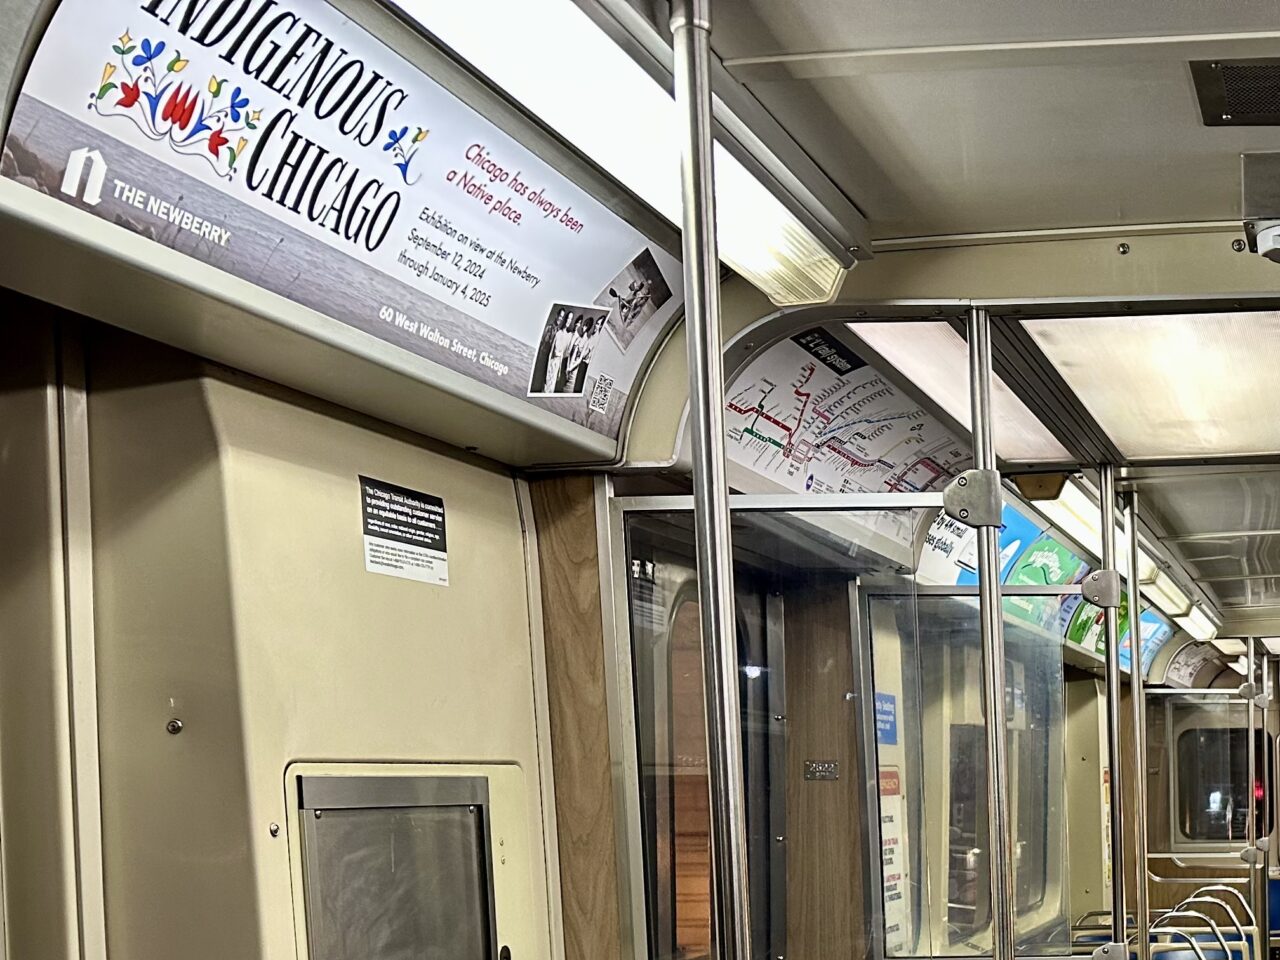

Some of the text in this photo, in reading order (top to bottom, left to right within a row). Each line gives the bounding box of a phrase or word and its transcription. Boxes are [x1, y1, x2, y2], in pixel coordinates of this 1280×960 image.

[245, 108, 402, 252] CHICAGO
[446, 169, 522, 226] a Native place.
[465, 143, 584, 234] Chicago has always been
[113, 179, 231, 247] THE NEWBERRY
[397, 248, 492, 308] through January 4, 2025
[408, 227, 488, 280] September 12, 2024
[418, 206, 542, 290] Exhibition on view at the Newberry
[379, 305, 509, 376] 60 West Walton Street, Chicago
[932, 536, 954, 559] globally
[950, 525, 969, 539] small
